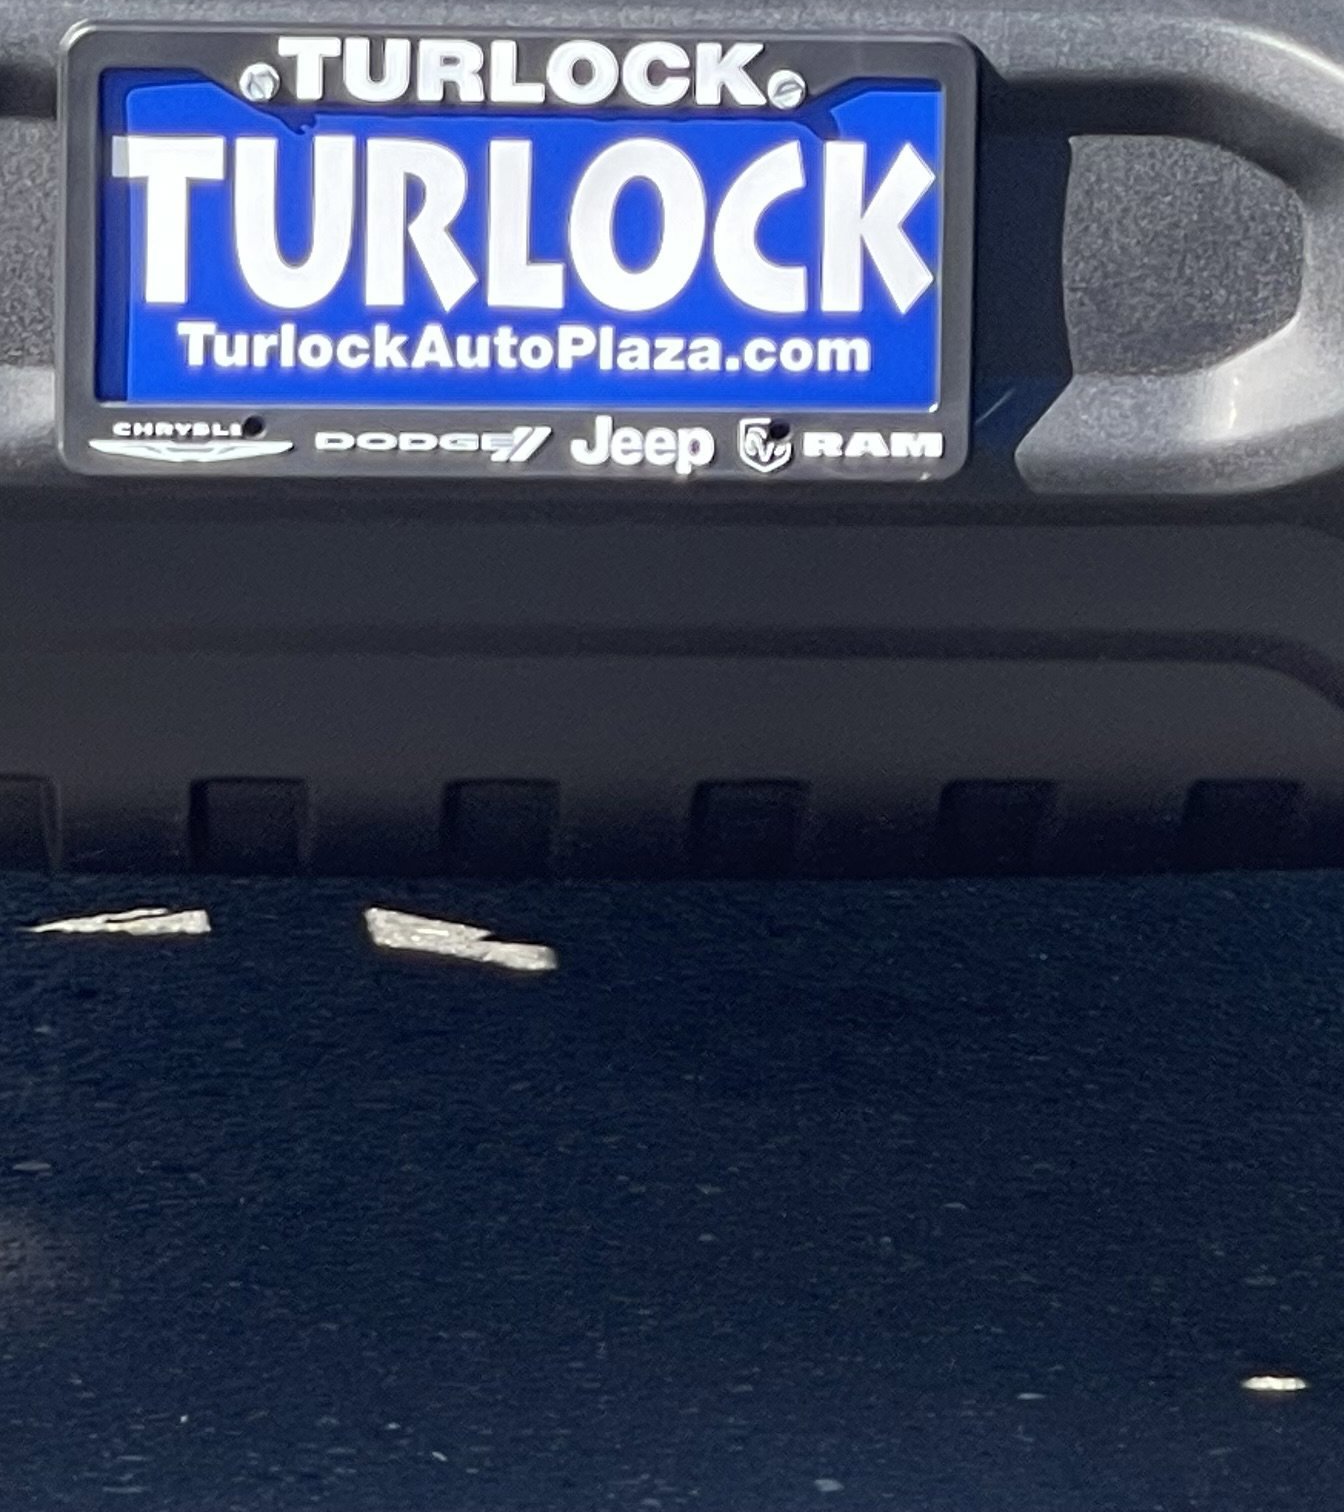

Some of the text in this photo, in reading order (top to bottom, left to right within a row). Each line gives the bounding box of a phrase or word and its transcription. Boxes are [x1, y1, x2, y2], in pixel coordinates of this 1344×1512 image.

[278, 36, 765, 107] TURLOCK
[112, 134, 937, 316] TURLOCK
[177, 320, 872, 374] TurlockAutoPlaza.com
[112, 414, 943, 475] CHRYSLE DODGE Jeep RAM
